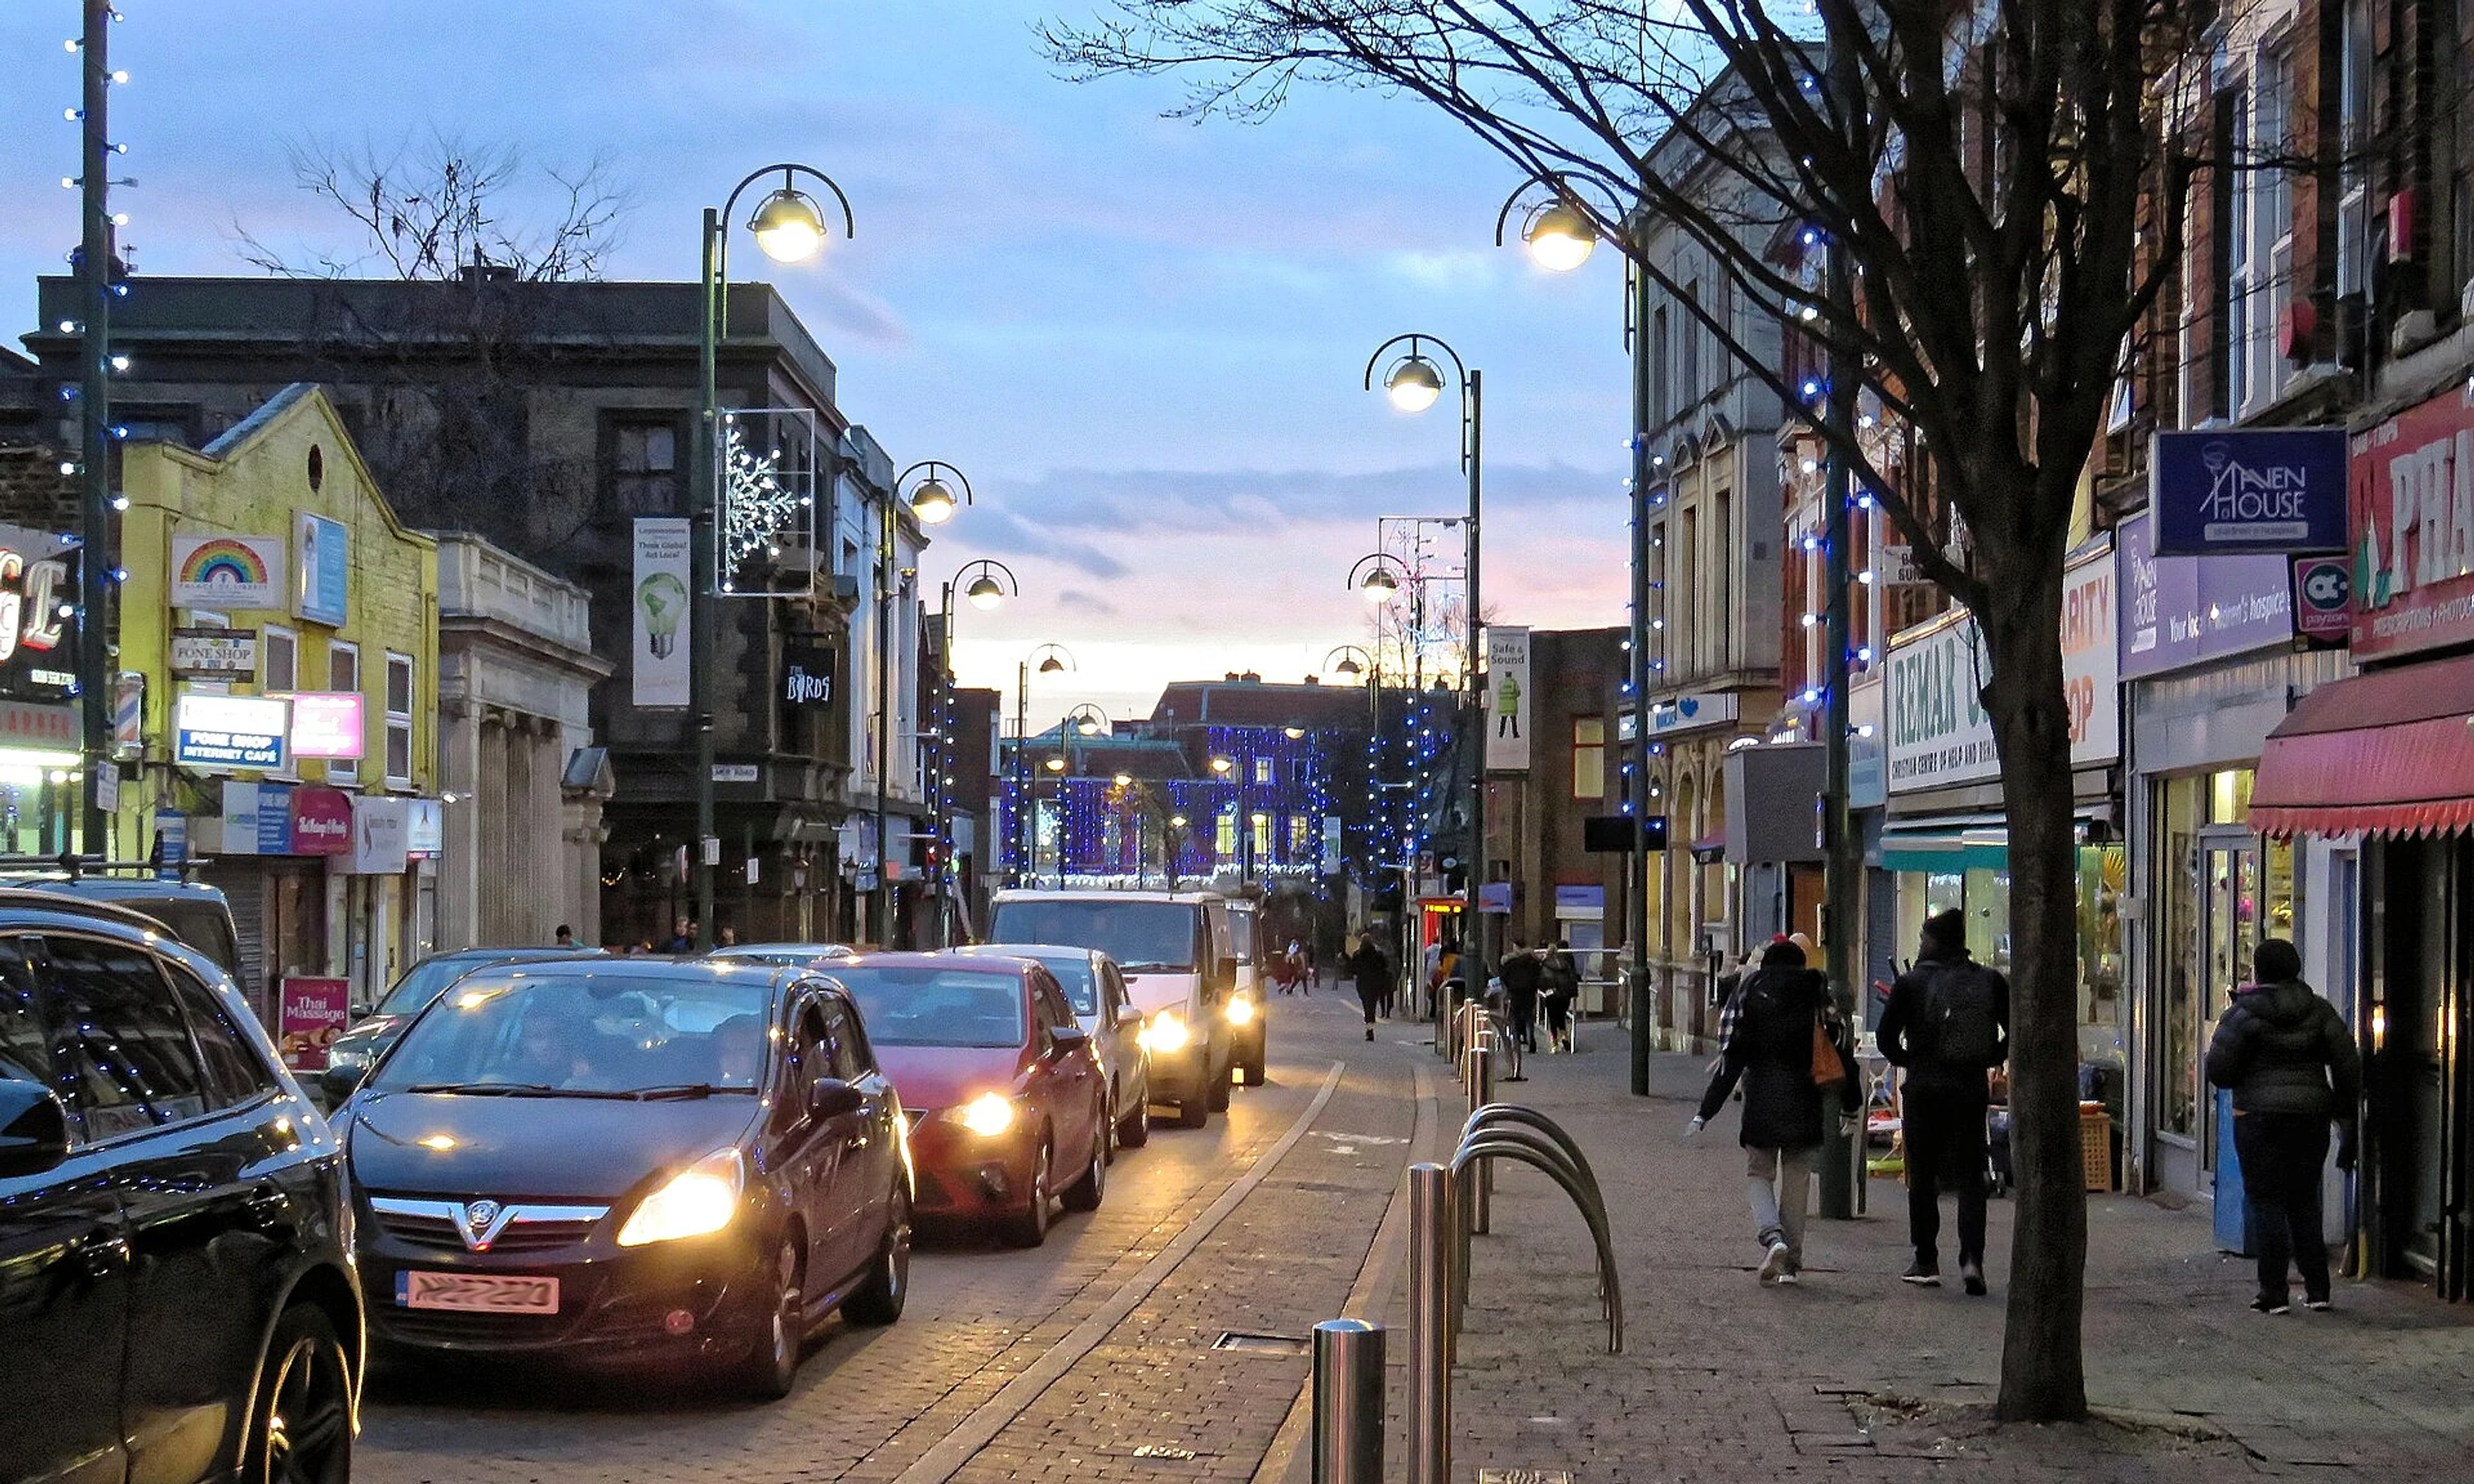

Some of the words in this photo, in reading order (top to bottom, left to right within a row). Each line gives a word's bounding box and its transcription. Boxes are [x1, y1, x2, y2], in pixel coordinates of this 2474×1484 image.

[2169, 615, 2186, 643] Your
[2249, 583, 2285, 623] hospice
[178, 647, 213, 659] FONE
[215, 649, 251, 660] SHOP
[1492, 643, 1515, 654] Safe
[1491, 654, 1525, 665] Sound
[2064, 674, 2095, 744] OP
[189, 731, 230, 747] FONE
[231, 734, 273, 750] SHOP
[183, 745, 244, 761] INTERNET
[244, 749, 278, 763] CAFÉ
[1948, 745, 1962, 770] HELP
[1965, 742, 1977, 765] AND
[298, 995, 328, 1010] Thai
[287, 1005, 346, 1023] Massage
